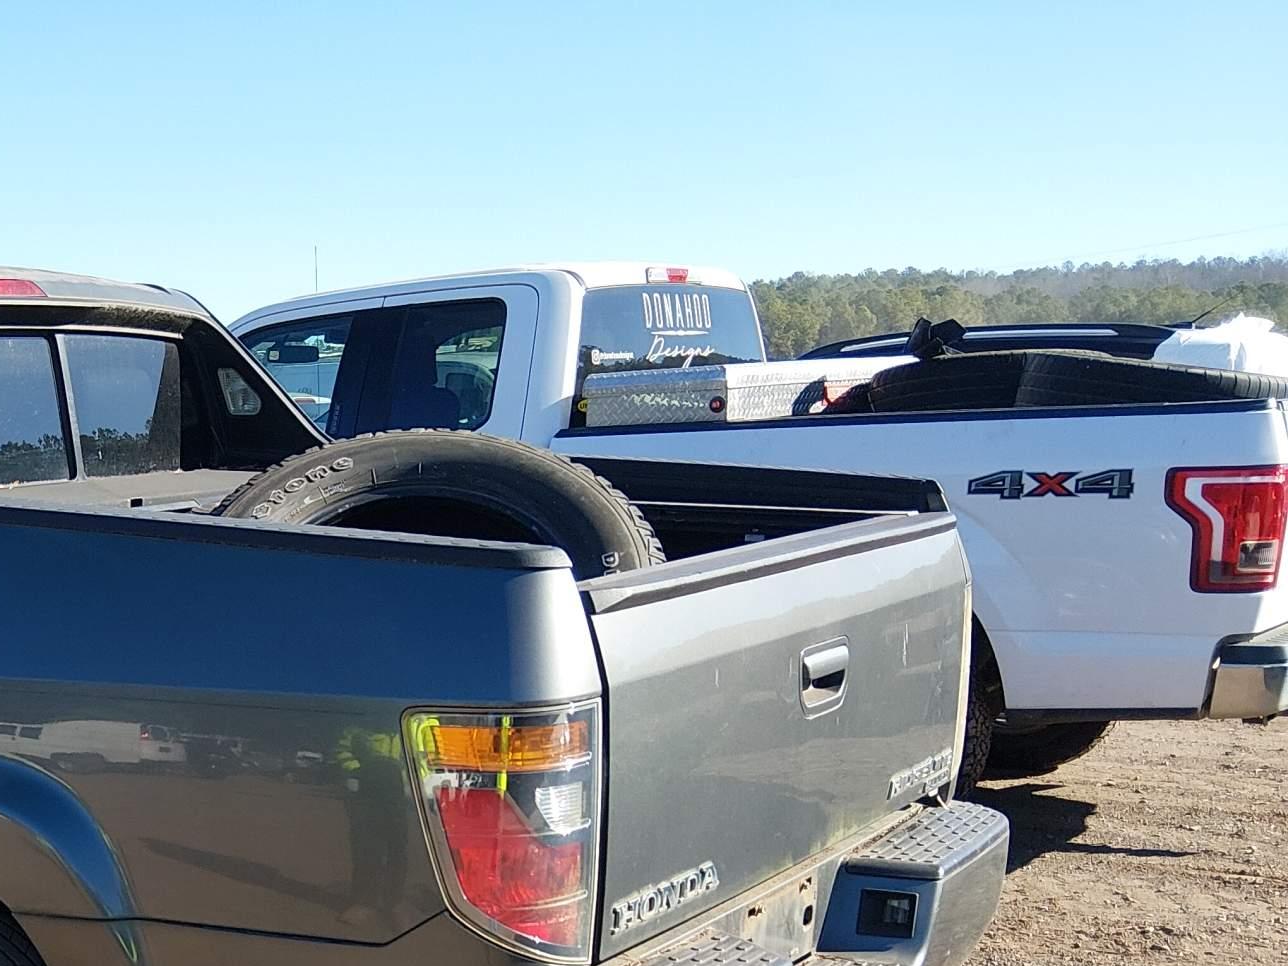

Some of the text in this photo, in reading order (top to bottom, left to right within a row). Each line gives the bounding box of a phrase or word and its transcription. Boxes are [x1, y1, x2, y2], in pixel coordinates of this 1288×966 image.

[642, 293, 712, 329] DONAHOO
[645, 335, 715, 368] Designs
[610, 860, 720, 936] HONDA
